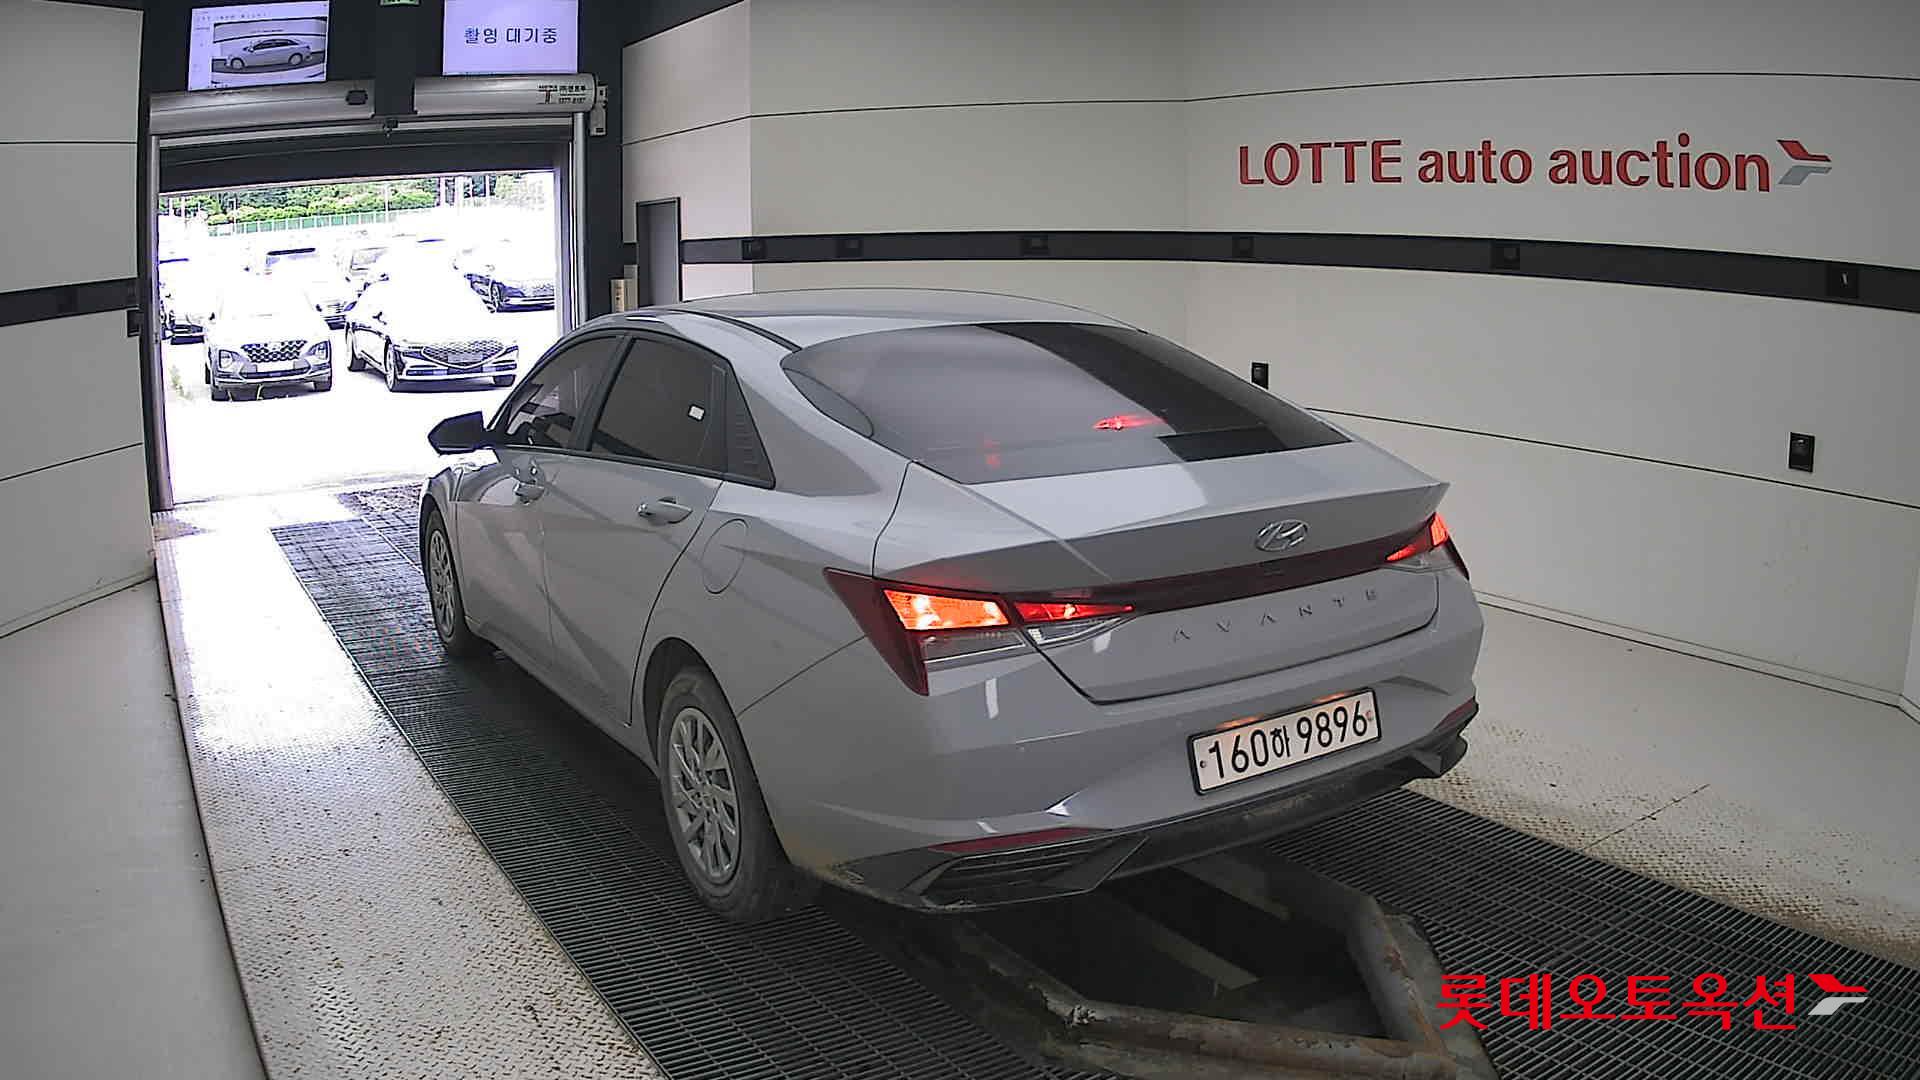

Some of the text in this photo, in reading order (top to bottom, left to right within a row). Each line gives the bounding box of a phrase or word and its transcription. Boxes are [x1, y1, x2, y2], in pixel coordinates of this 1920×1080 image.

[505, 27, 557, 44] 대기중
[1238, 132, 1771, 193] LOTTE auto auction
[1173, 588, 1377, 642] AVANTE
